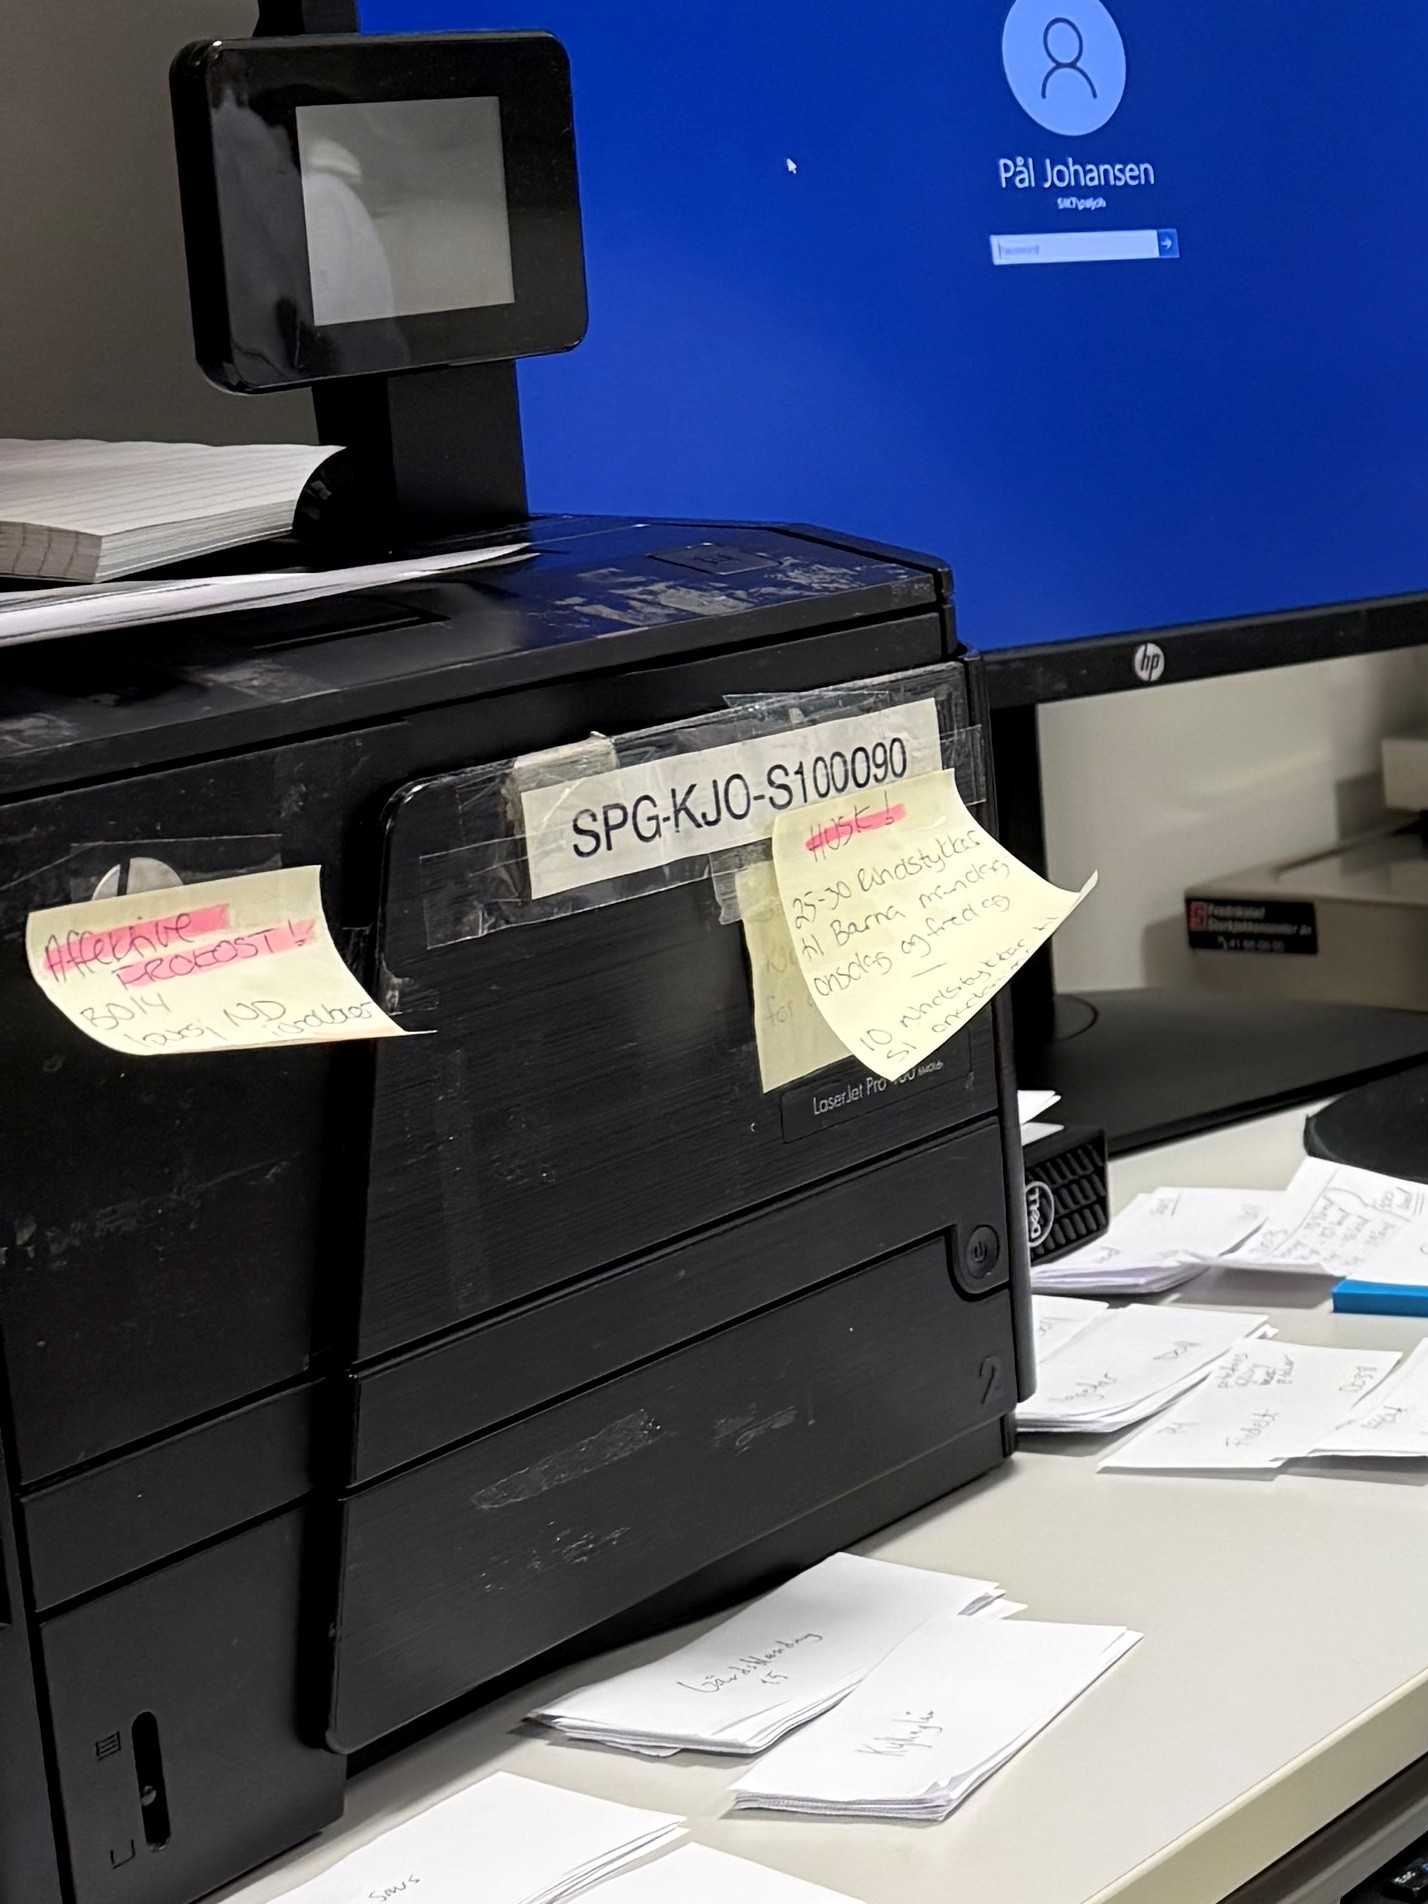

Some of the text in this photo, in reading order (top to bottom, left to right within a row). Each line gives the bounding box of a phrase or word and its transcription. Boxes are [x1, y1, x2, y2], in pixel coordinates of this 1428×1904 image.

[998, 156, 1156, 189] Pål Johansen
[572, 737, 908, 859] SPG-KJO-S100090
[812, 1082, 864, 1116] LaserJet
[866, 1076, 887, 1096] Pro
[1028, 1187, 1043, 1241] DELL
